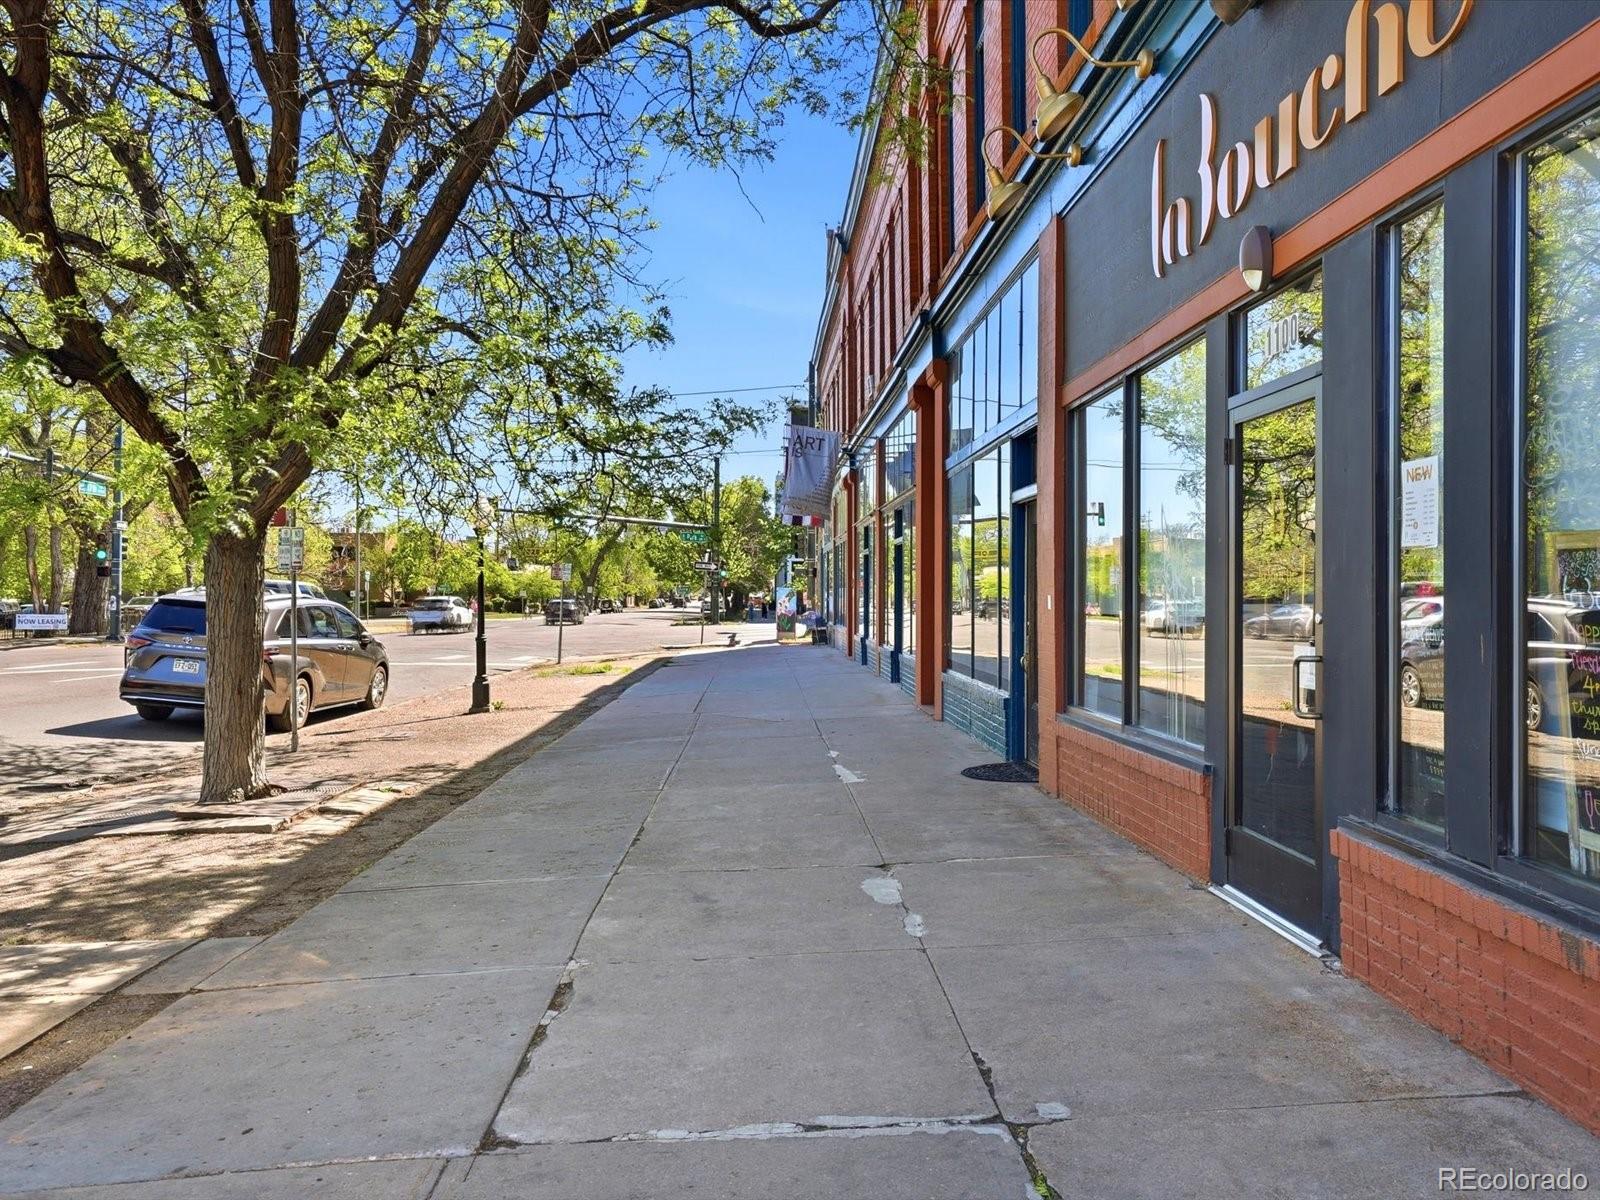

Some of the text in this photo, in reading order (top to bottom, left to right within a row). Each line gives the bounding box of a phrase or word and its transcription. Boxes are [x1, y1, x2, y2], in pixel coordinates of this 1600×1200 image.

[1265, 314, 1298, 356] 1100
[793, 435, 826, 451] ART
[791, 447, 803, 458] IS
[1406, 464, 1433, 483] NEW
